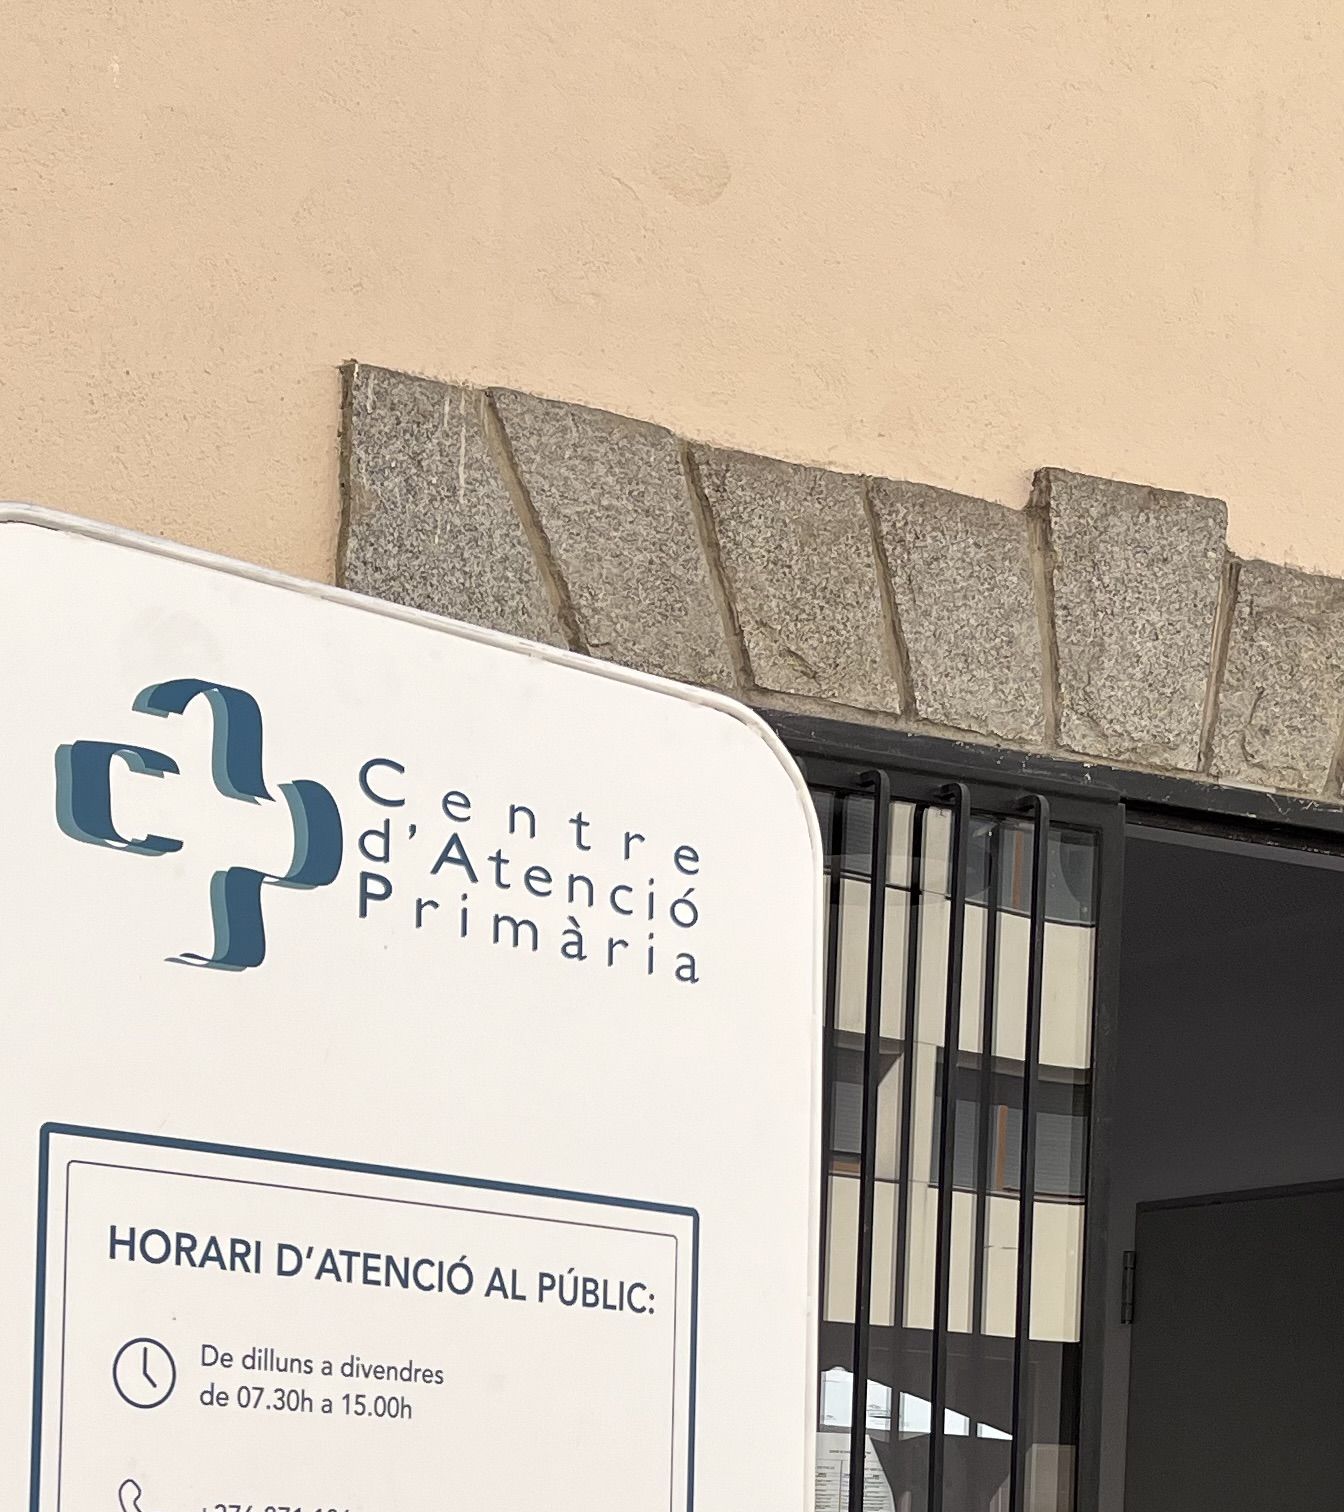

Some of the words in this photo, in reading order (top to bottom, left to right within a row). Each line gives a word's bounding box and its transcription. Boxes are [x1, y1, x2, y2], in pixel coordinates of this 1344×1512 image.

[358, 757, 700, 876] Centre
[357, 817, 699, 929] d'Atenció
[358, 870, 700, 985] Primària
[109, 1224, 262, 1274] HORARI
[276, 1242, 474, 1296] D'ATENCIÓ
[484, 1266, 527, 1302] AL
[538, 1267, 655, 1315] PÚBLIC:
[199, 1382, 230, 1407] de
[236, 1385, 313, 1413] 07.30h
[321, 1398, 333, 1414] a
[342, 1393, 412, 1420] 15.00h
[201, 1343, 234, 1369] De
[241, 1346, 314, 1375] dilluns
[320, 1360, 333, 1376] a
[340, 1354, 444, 1385] divendres
